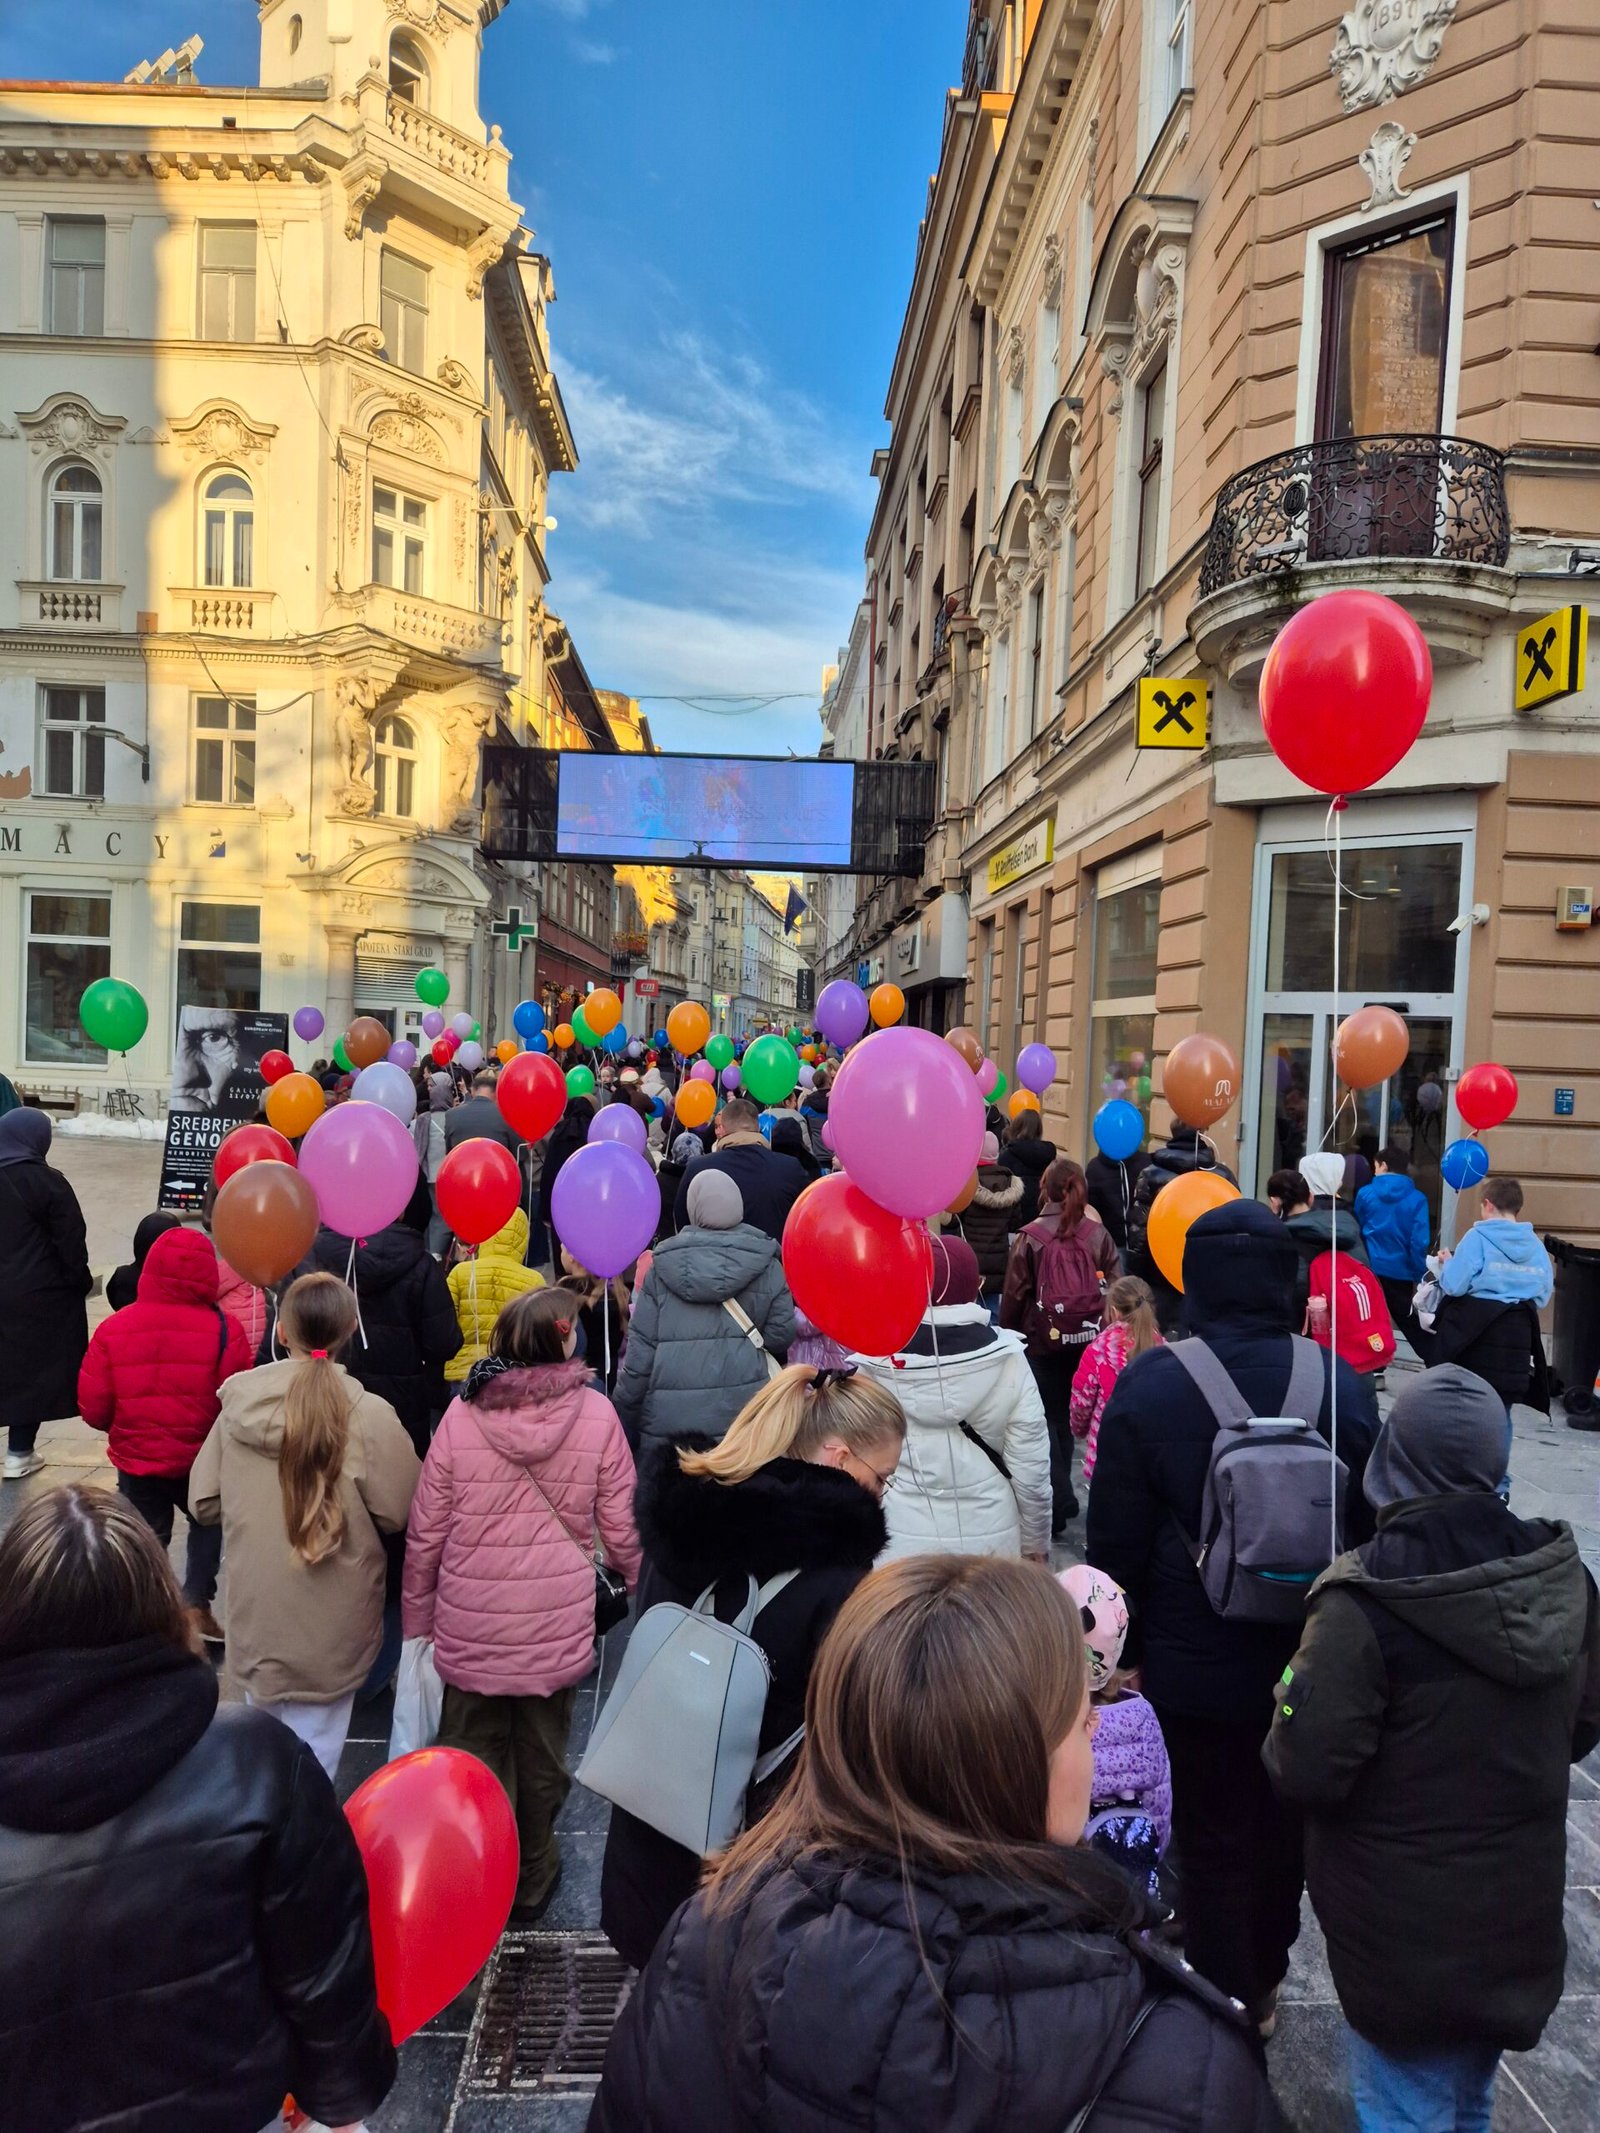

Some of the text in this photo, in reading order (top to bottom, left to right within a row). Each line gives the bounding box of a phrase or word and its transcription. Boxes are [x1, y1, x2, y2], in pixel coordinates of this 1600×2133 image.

[1372, 0, 1417, 32] 1897
[1, 827, 169, 859] MACY
[1024, 836, 1038, 863] Bank
[359, 941, 433, 958] APOTEKA STARI GRAD
[169, 1131, 221, 1147] GENO
